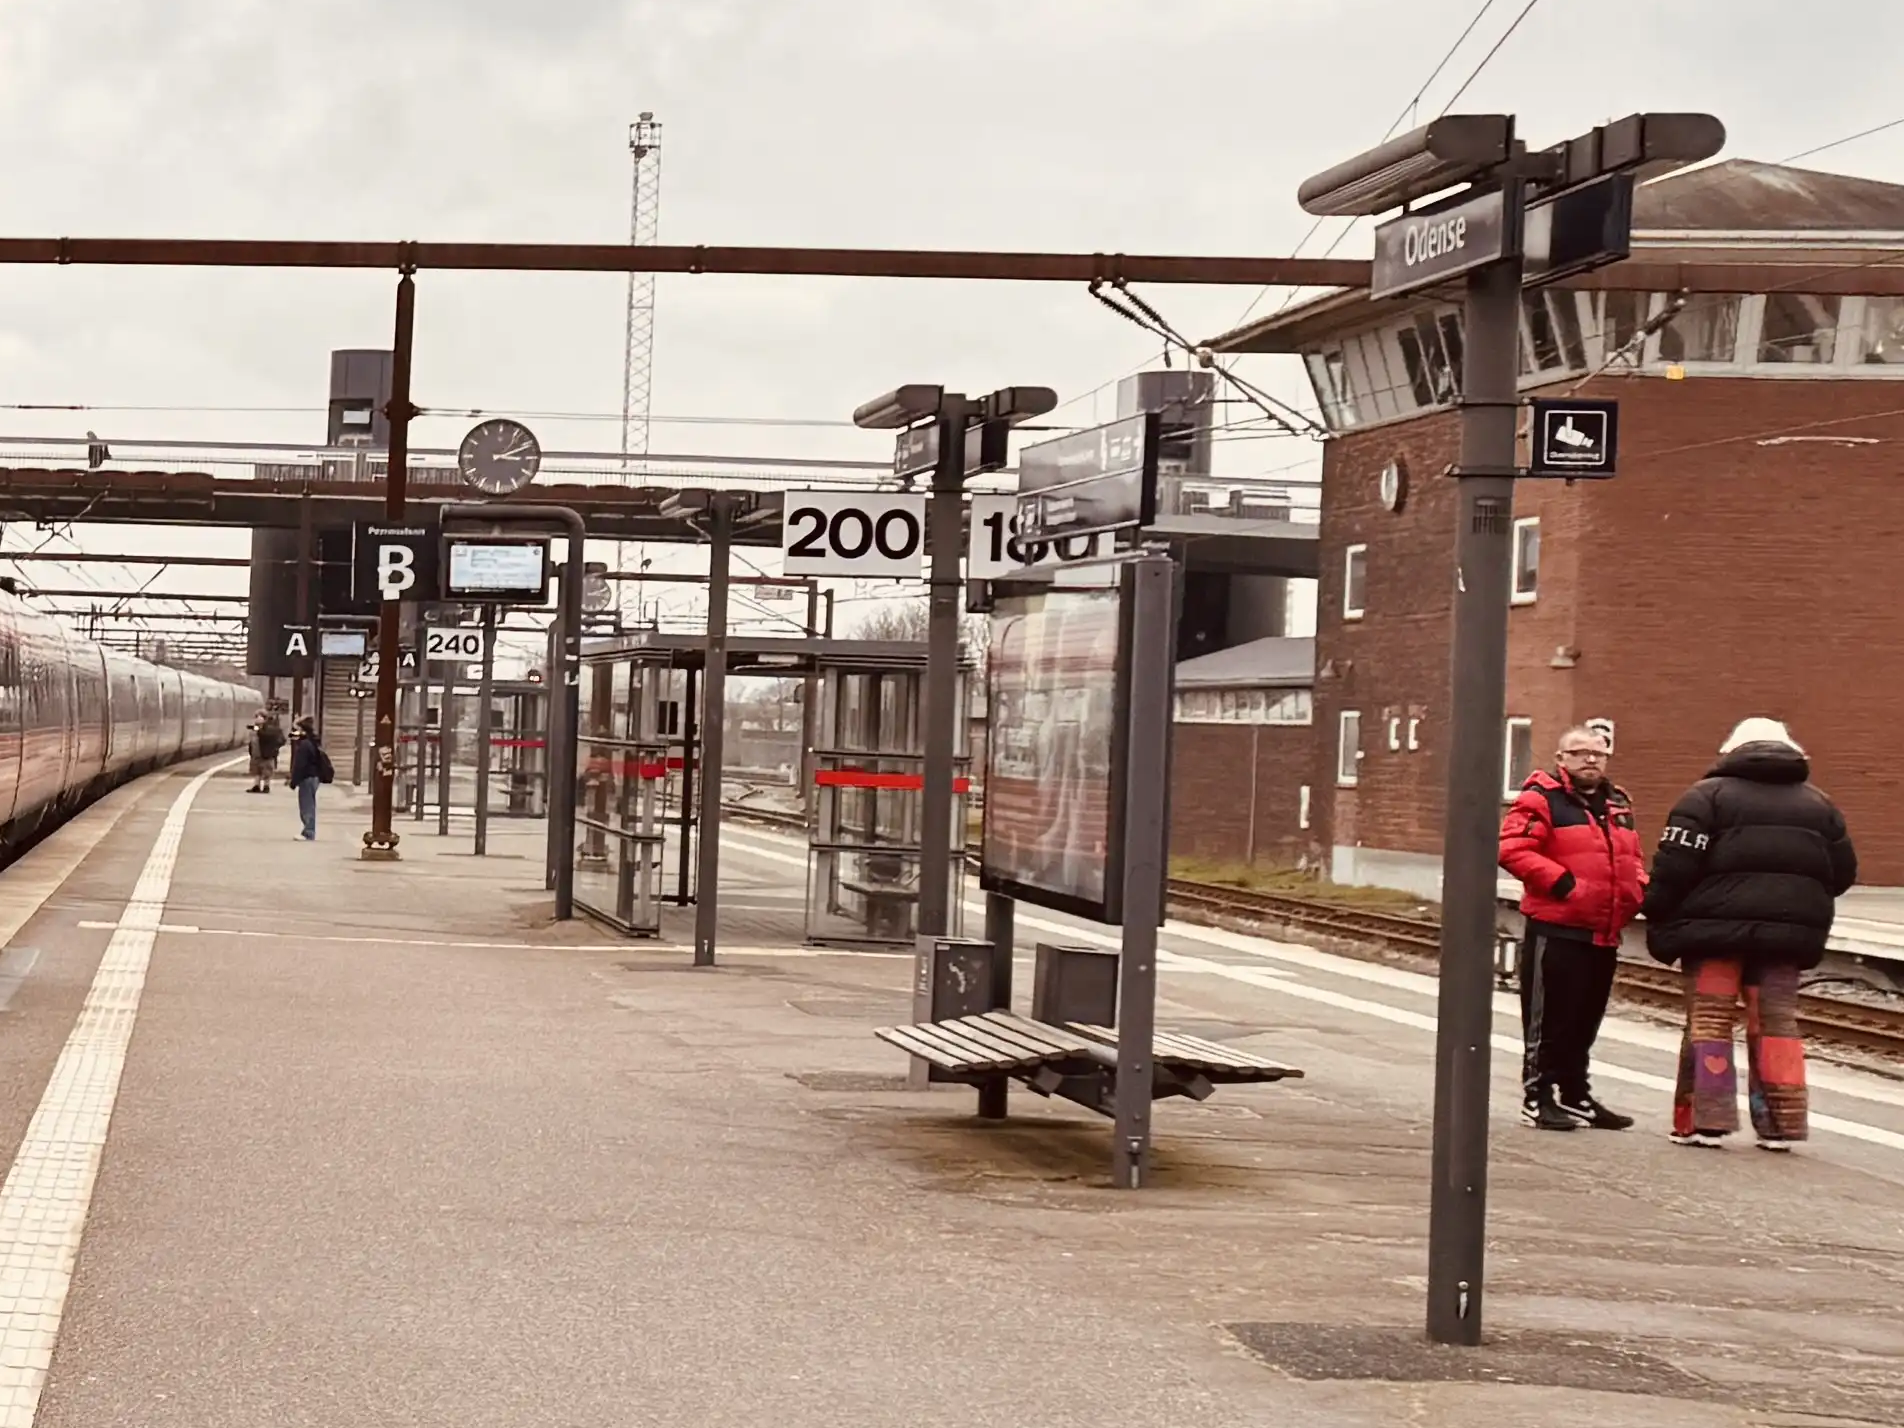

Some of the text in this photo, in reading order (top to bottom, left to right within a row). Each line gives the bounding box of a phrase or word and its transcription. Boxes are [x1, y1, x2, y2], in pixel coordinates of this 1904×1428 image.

[1404, 215, 1466, 266] Odense
[787, 507, 920, 559] 200
[378, 544, 415, 591] B
[286, 632, 308, 656] A
[402, 653, 416, 667] A
[428, 634, 479, 656] 240
